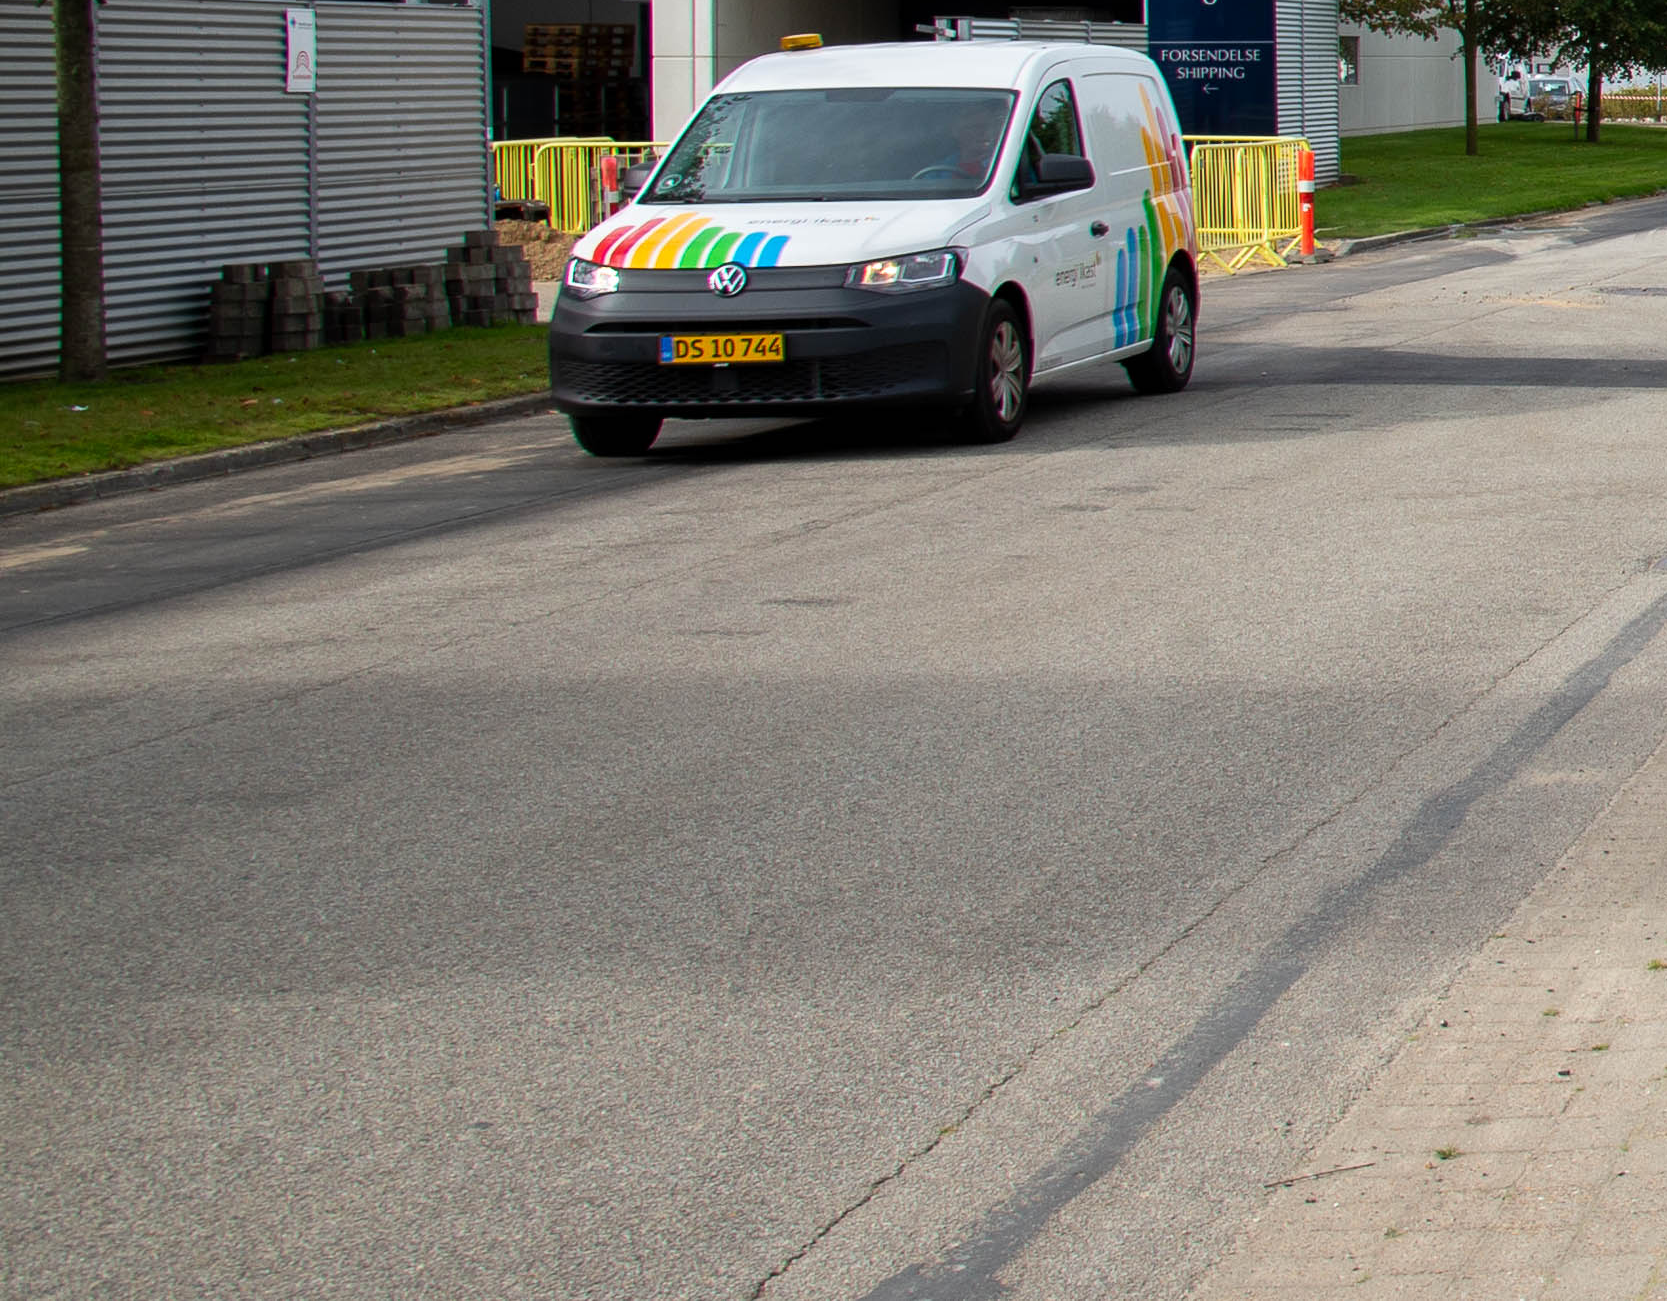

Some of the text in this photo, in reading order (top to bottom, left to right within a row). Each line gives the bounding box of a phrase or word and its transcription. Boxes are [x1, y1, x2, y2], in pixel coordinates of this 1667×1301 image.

[1161, 49, 1261, 62] FORSENDELSE
[1176, 66, 1246, 80] SHIPPING
[675, 337, 780, 359] DS 10 744
